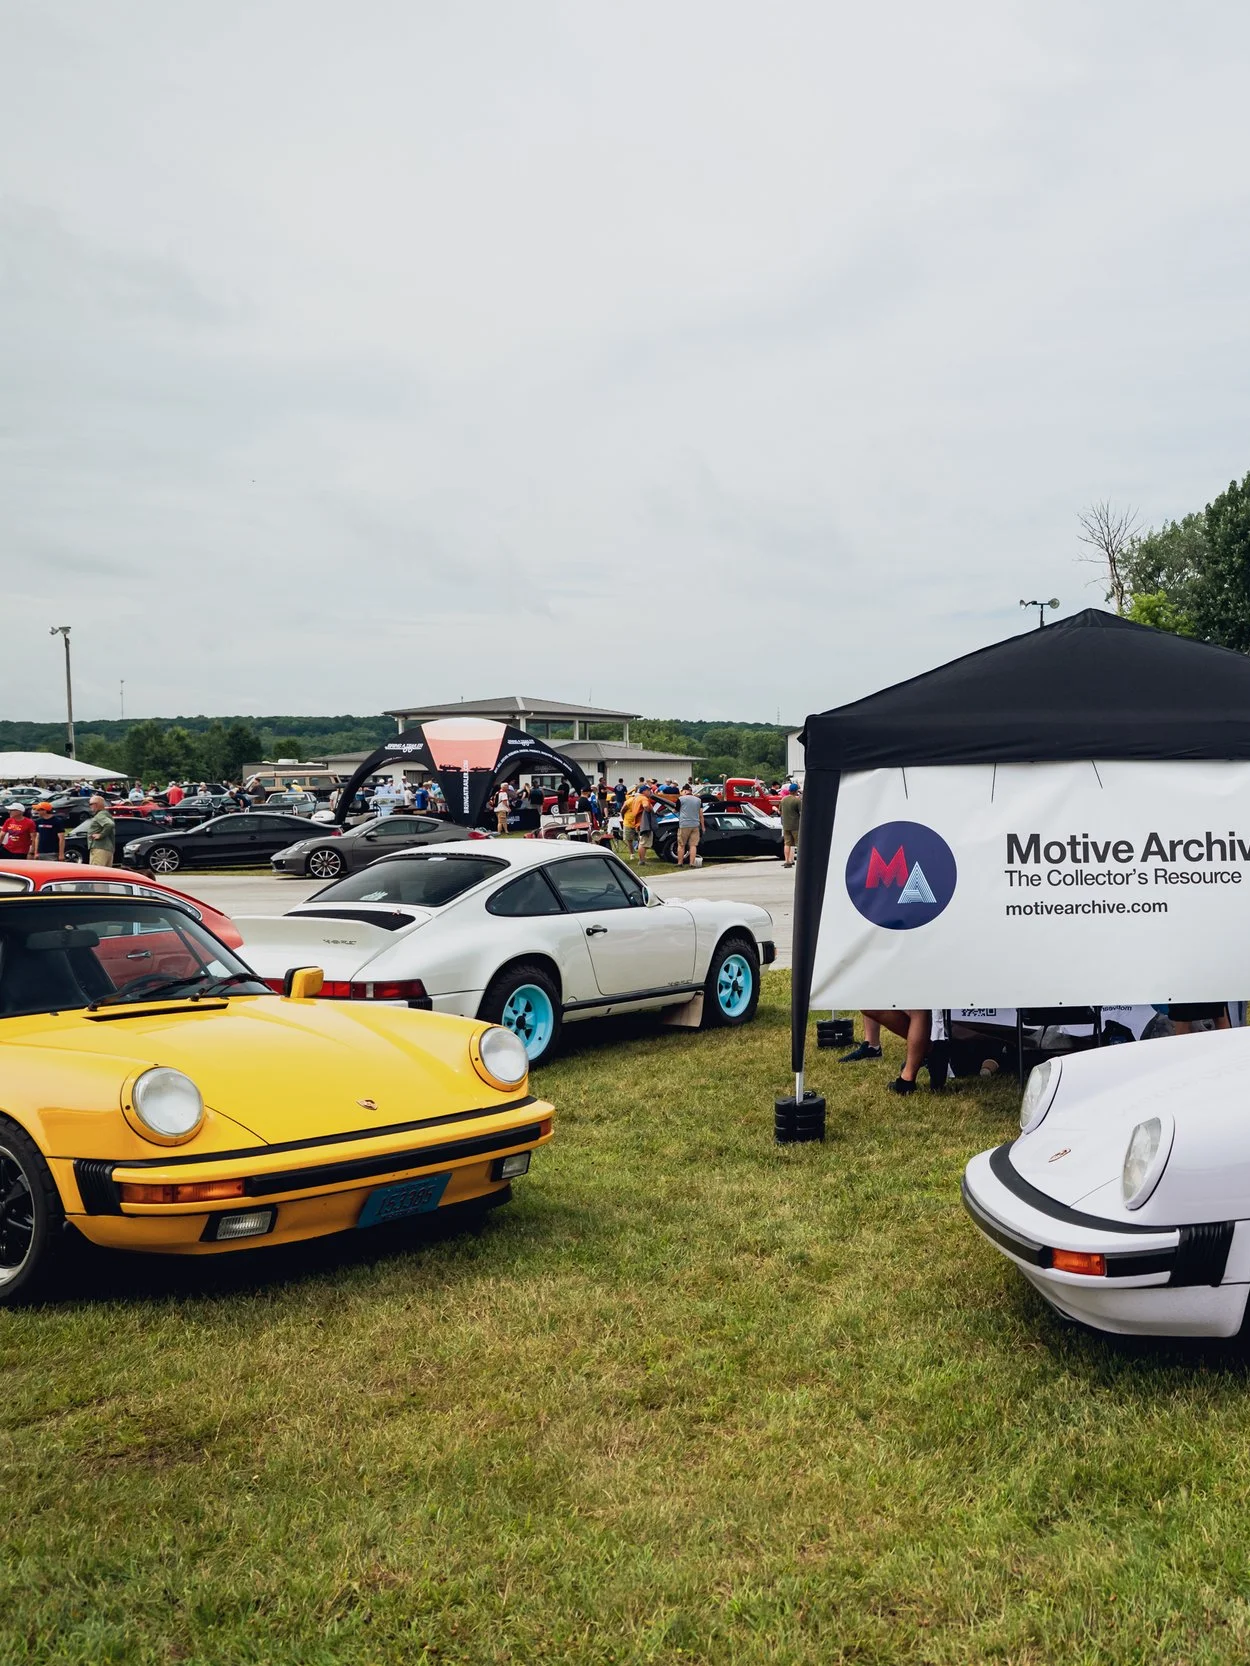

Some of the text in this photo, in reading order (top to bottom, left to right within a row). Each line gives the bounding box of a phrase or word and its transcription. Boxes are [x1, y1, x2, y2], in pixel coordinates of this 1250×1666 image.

[1006, 833, 1135, 864] Motive
[865, 845, 937, 904] MA
[1005, 868, 1242, 887] The Collector’s Resource
[1005, 900, 1168, 915] motivearchive.com
